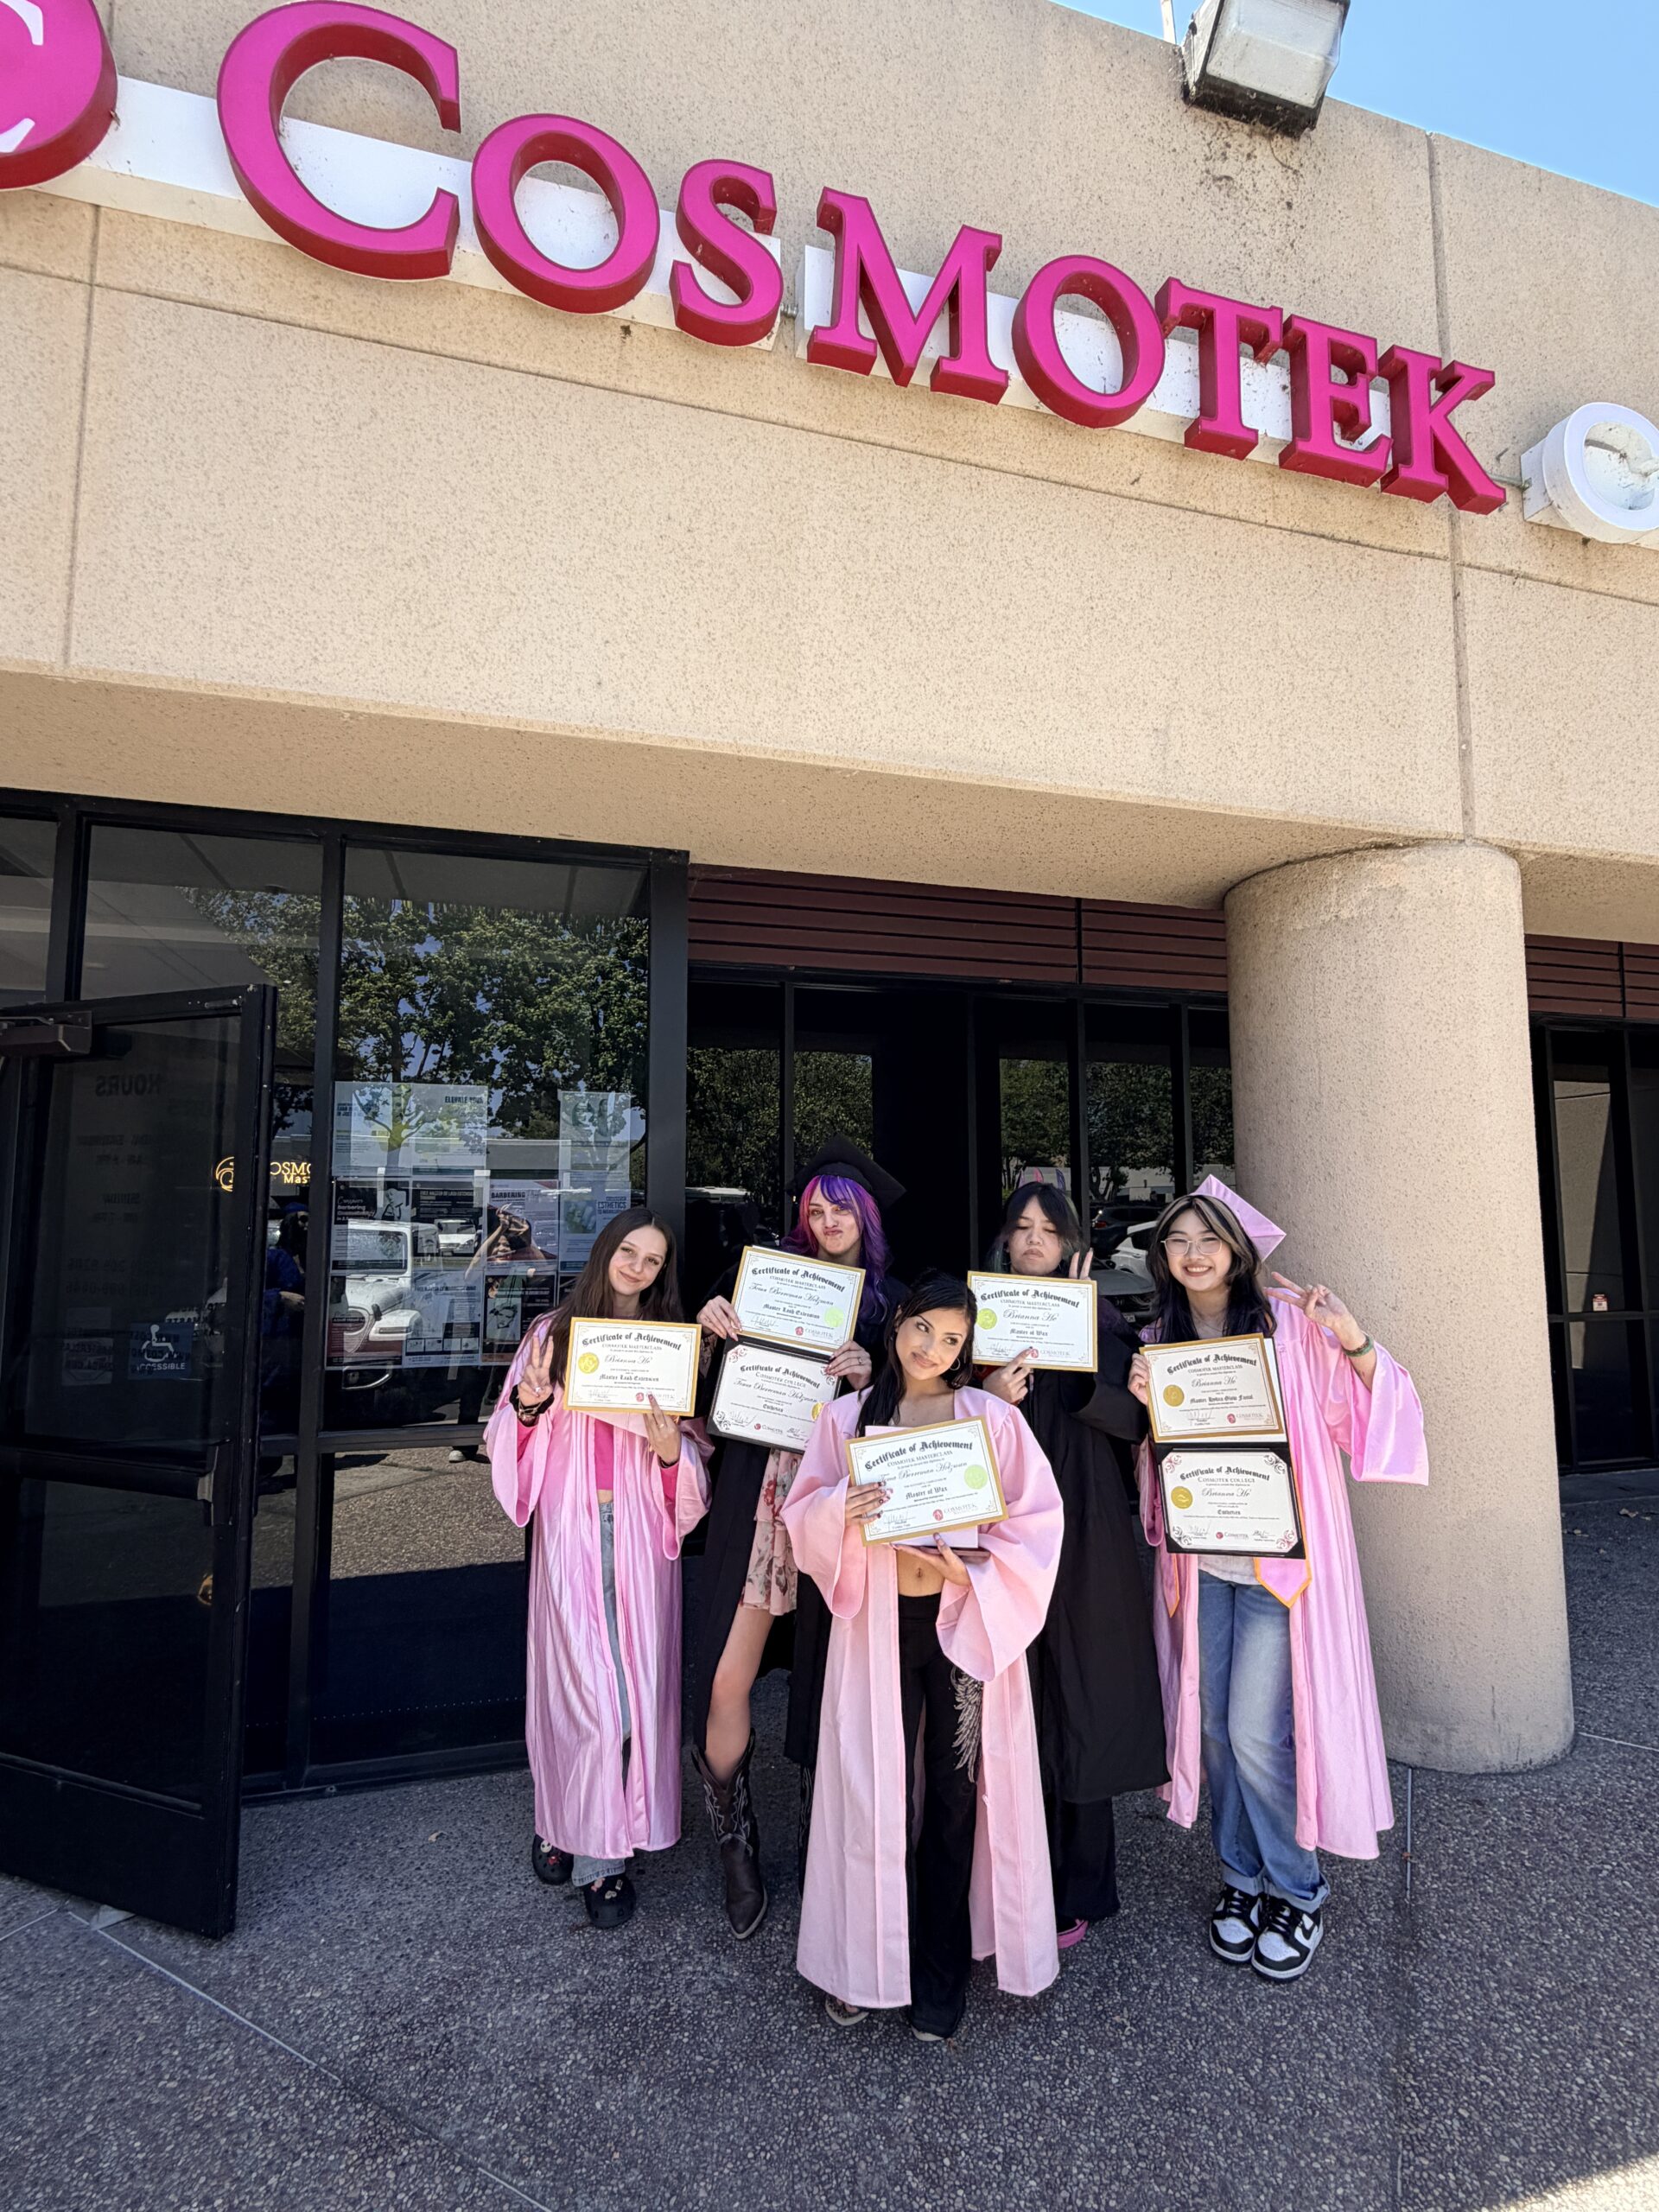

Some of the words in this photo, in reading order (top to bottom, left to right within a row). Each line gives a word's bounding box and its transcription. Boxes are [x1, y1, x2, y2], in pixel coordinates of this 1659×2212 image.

[217, 0, 1506, 516] COSMOTEK
[801, 1270, 846, 1293] Achievement
[981, 1290, 1020, 1300] Certificate
[1031, 1289, 1080, 1308] Achievement
[1003, 1309, 1039, 1320] Brianna
[1041, 1312, 1059, 1321] He
[582, 1333, 623, 1346] Certificate
[634, 1332, 682, 1351] Achievement
[137, 1363, 186, 1371] CCESSIBLE
[1167, 1358, 1202, 1375] Certificate
[1212, 1354, 1257, 1367] Achievement
[782, 1368, 821, 1389] Achievement
[865, 1447, 906, 1471] Certificate
[909, 1444, 917, 1452] of
[919, 1440, 973, 1452] Achievement
[887, 1457, 915, 1467] COSMOTEK
[916, 1451, 953, 1461] MASTERCLASS
[1180, 1469, 1215, 1480] Certificate
[1224, 1466, 1270, 1481] Achievement
